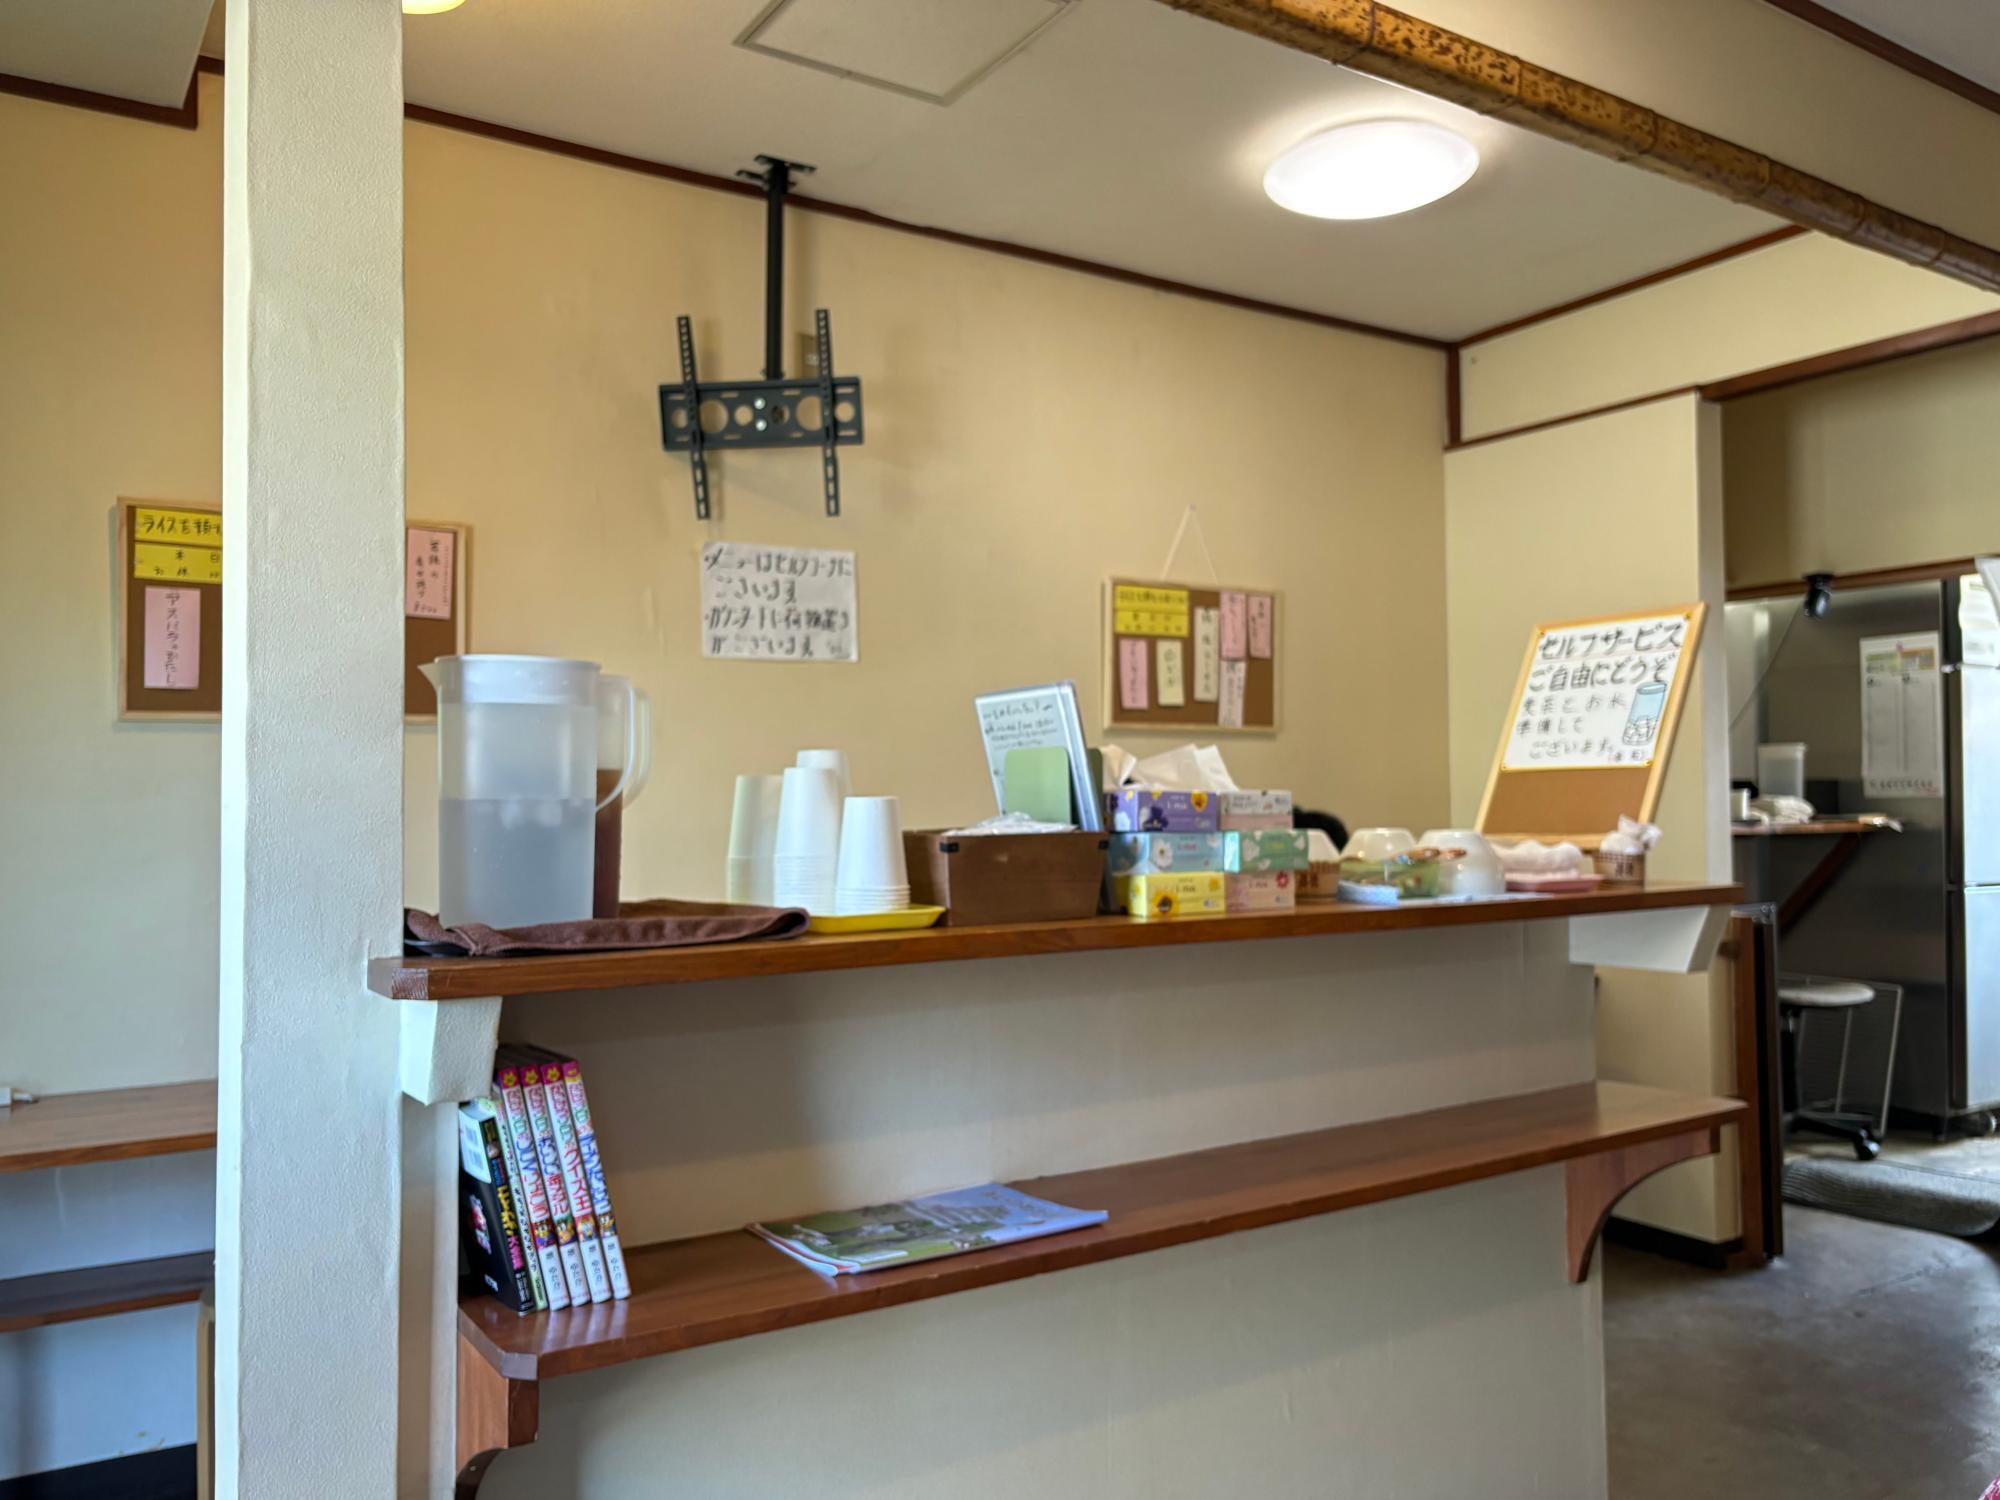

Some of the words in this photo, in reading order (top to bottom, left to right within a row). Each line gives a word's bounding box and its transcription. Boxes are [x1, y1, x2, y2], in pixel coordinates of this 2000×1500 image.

[1538, 621, 1683, 661] セルフサービス
[1529, 652, 1677, 692] ご自由にどうぞ
